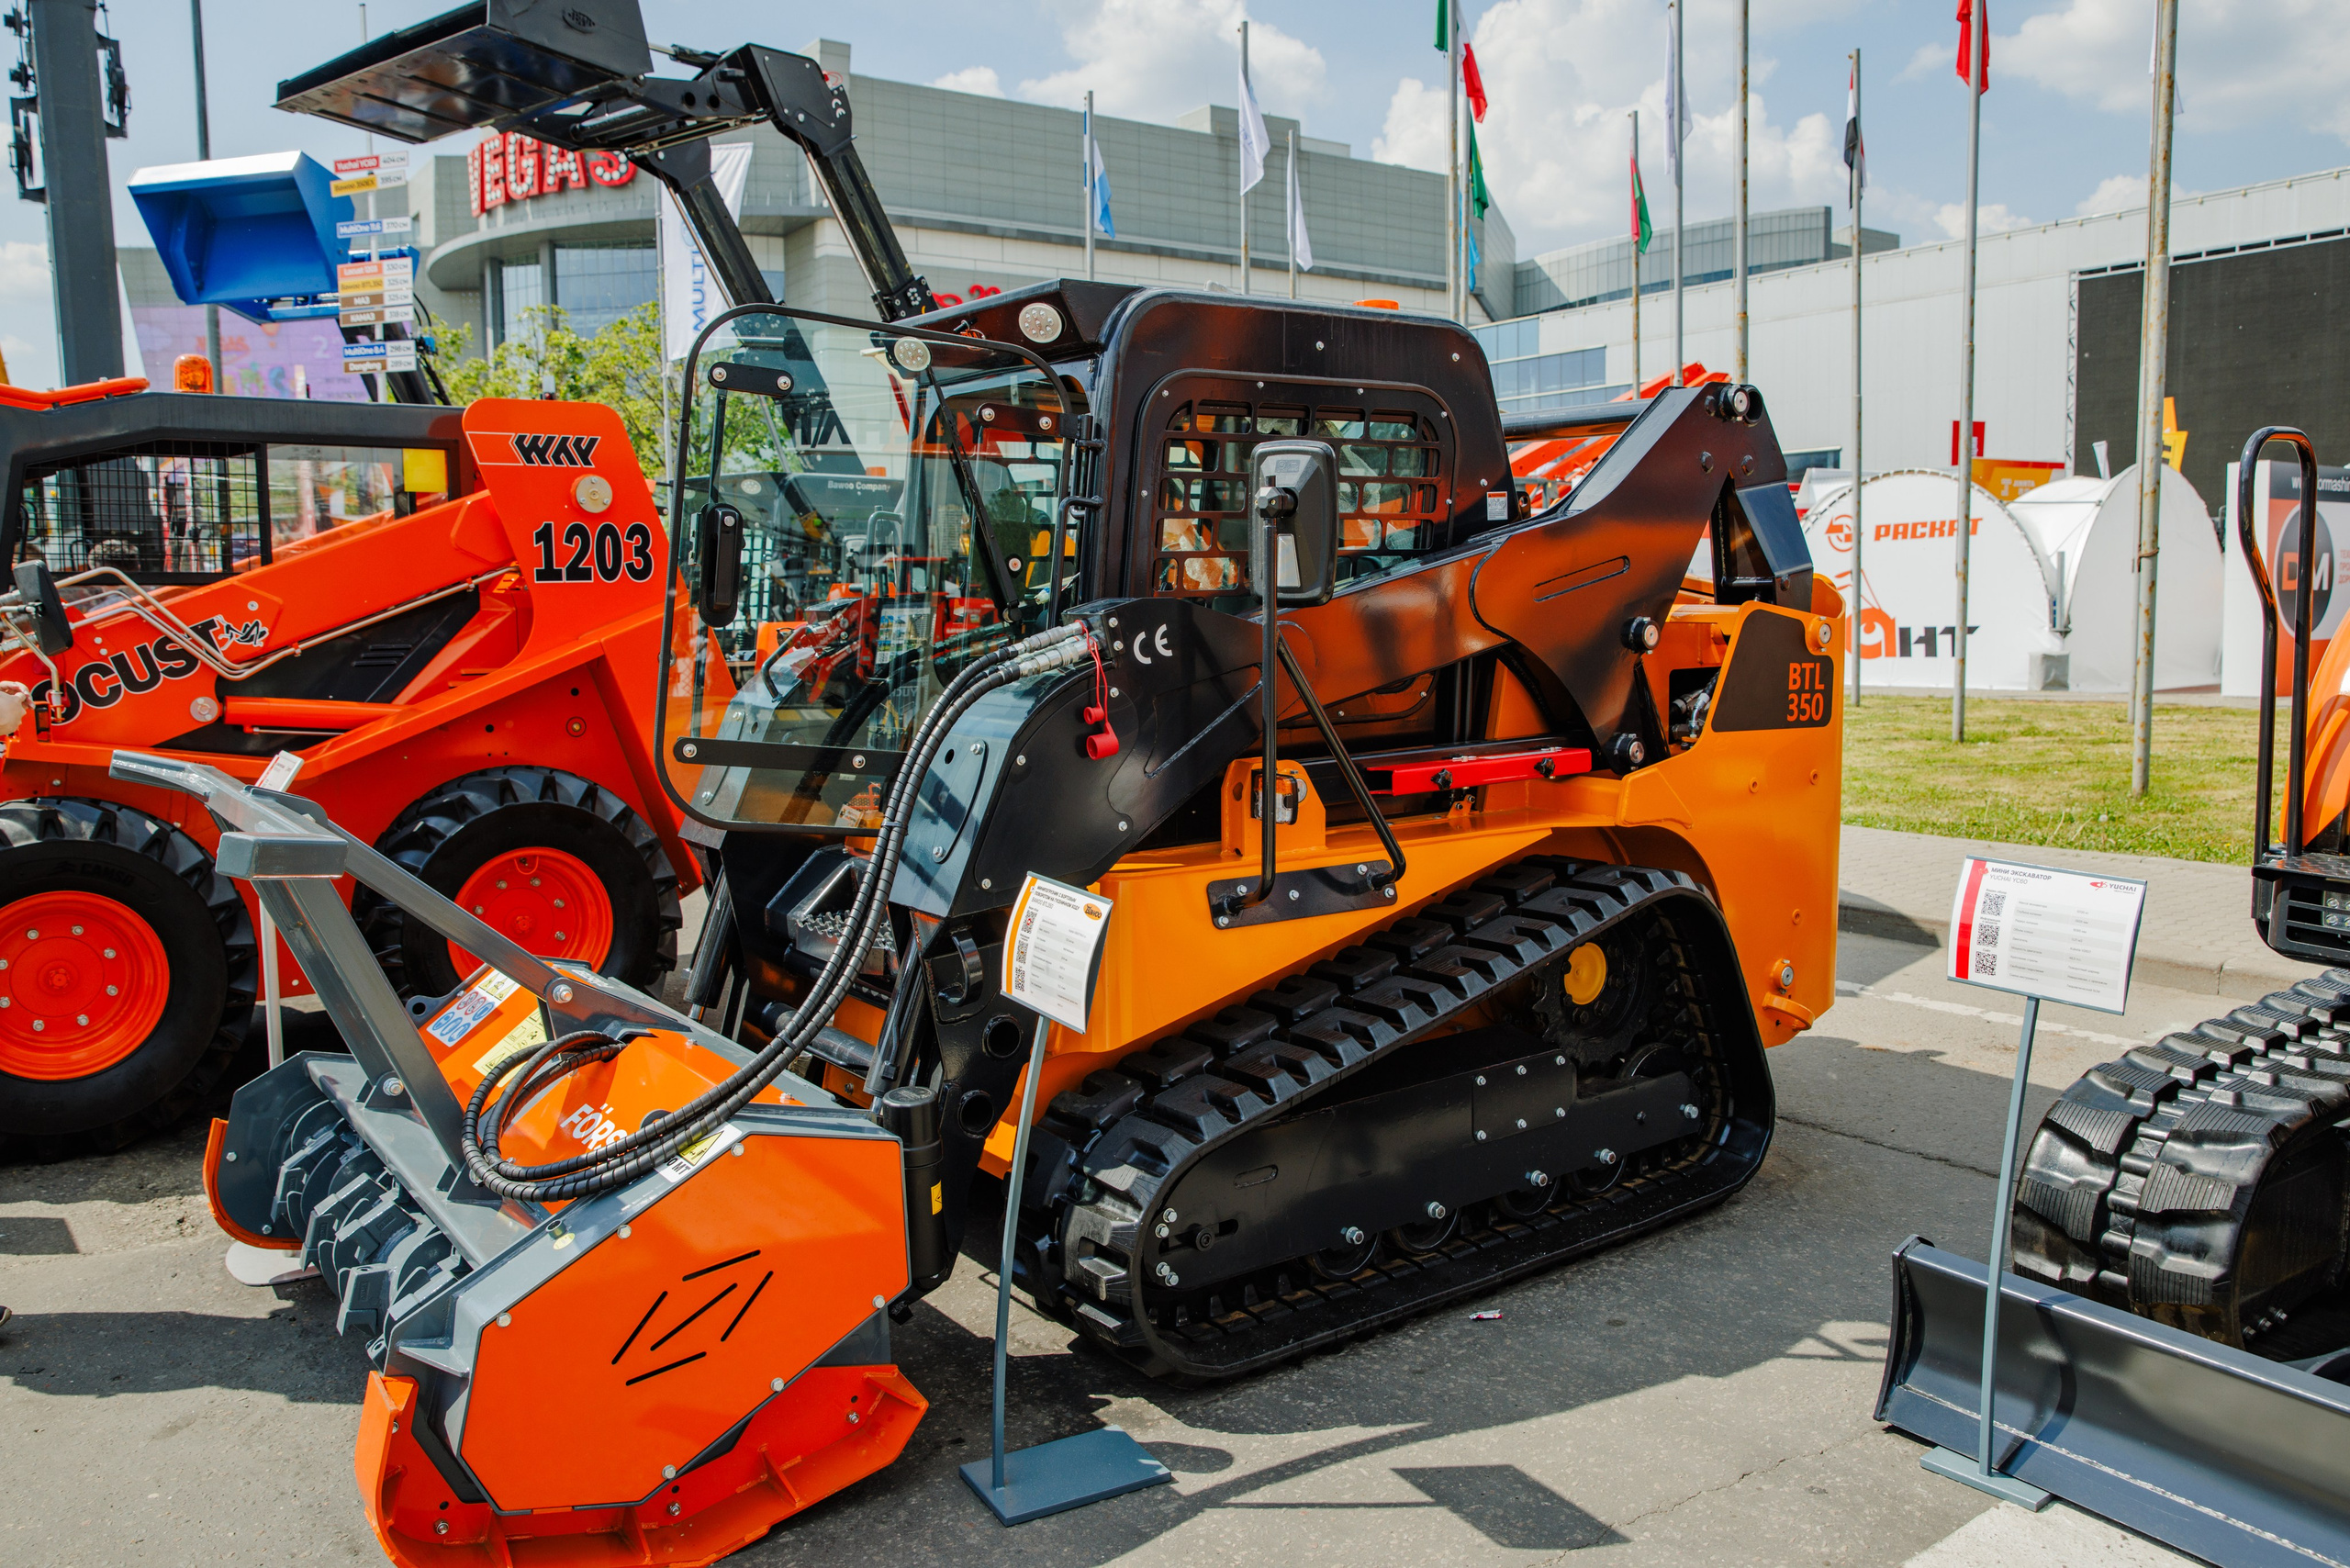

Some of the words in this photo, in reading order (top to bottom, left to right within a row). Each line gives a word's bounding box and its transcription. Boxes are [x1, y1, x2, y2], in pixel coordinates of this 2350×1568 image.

[467, 130, 639, 218] VEGAS
[827, 479, 854, 490] Bawoo
[855, 481, 891, 493] Company
[533, 521, 655, 584] 1203
[1133, 623, 1173, 665] CE
[30, 617, 225, 726] OCUST
[1788, 662, 1825, 690] BTL
[1786, 692, 1824, 722] 350
[1991, 867, 2009, 875] МИНИ
[2010, 869, 2052, 880] ЭКСКАВАТОР
[2109, 882, 2137, 892] YUCHAI
[560, 1103, 628, 1151] FÖRS
